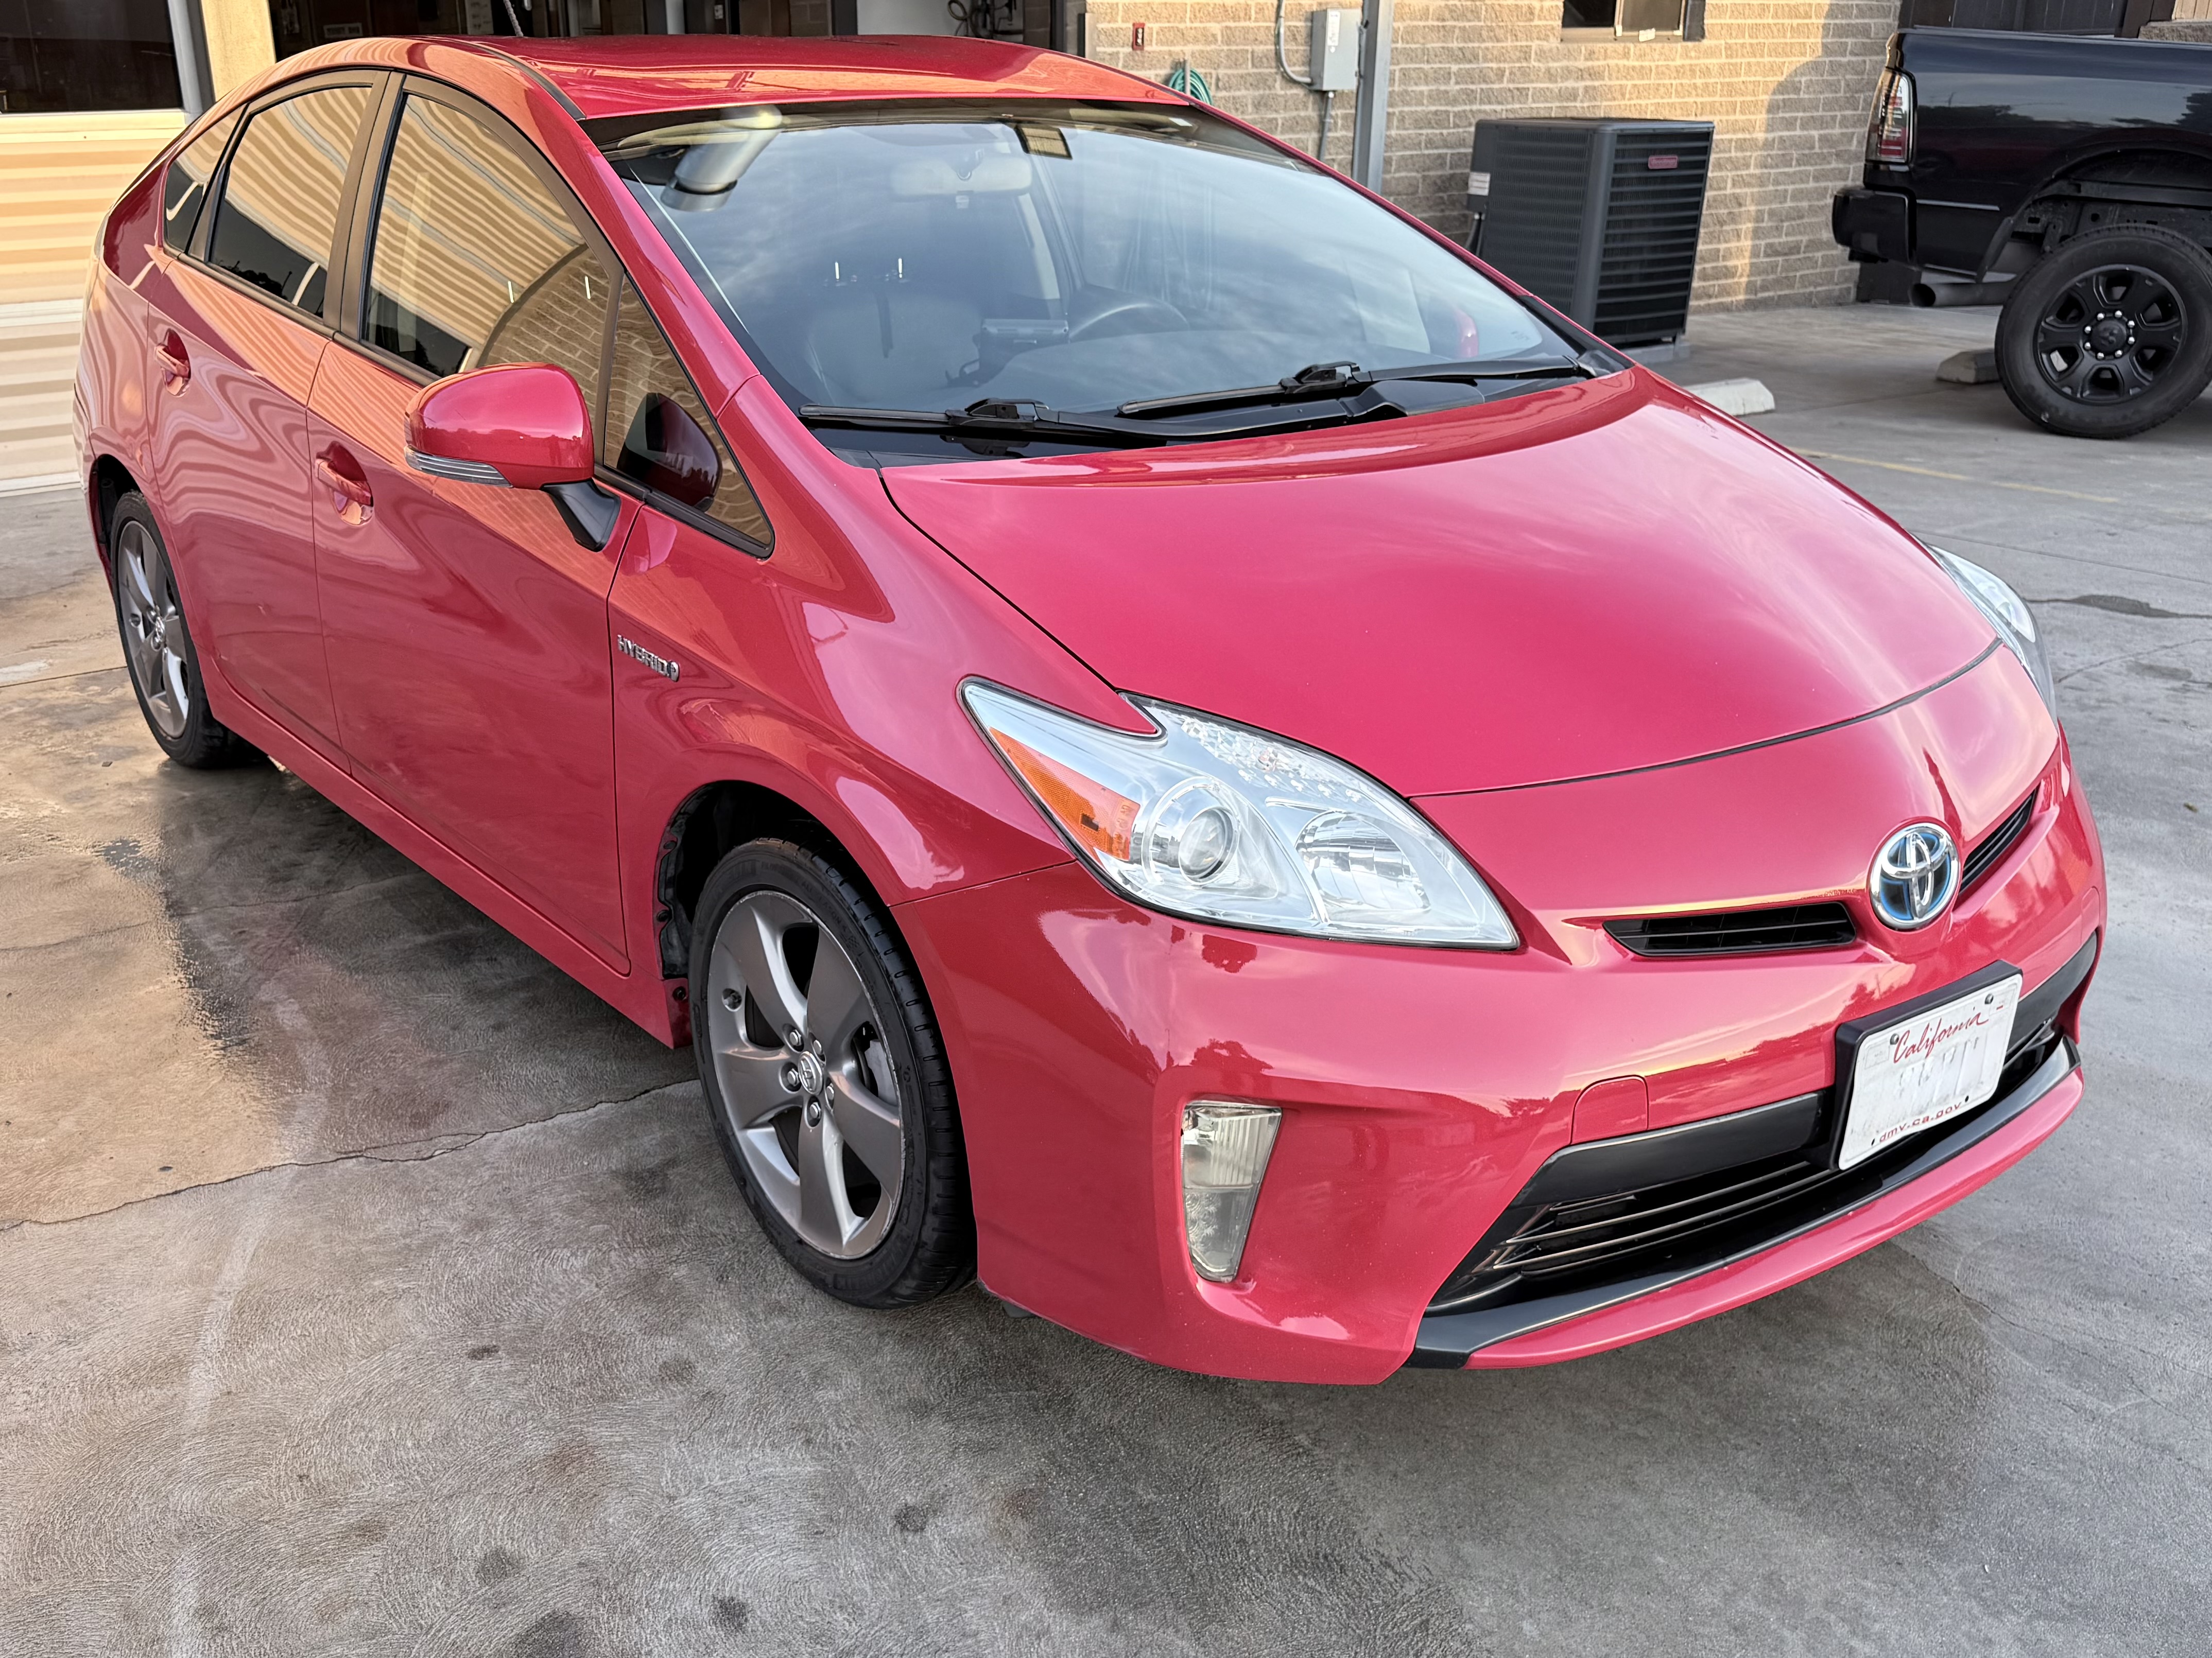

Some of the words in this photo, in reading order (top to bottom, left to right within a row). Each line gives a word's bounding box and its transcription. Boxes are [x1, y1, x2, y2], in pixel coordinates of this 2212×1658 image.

[617, 634, 669, 677] HYBRID
[1893, 1006, 1989, 1063] California
[1879, 1102, 1962, 1143] dmv.ca.gov
